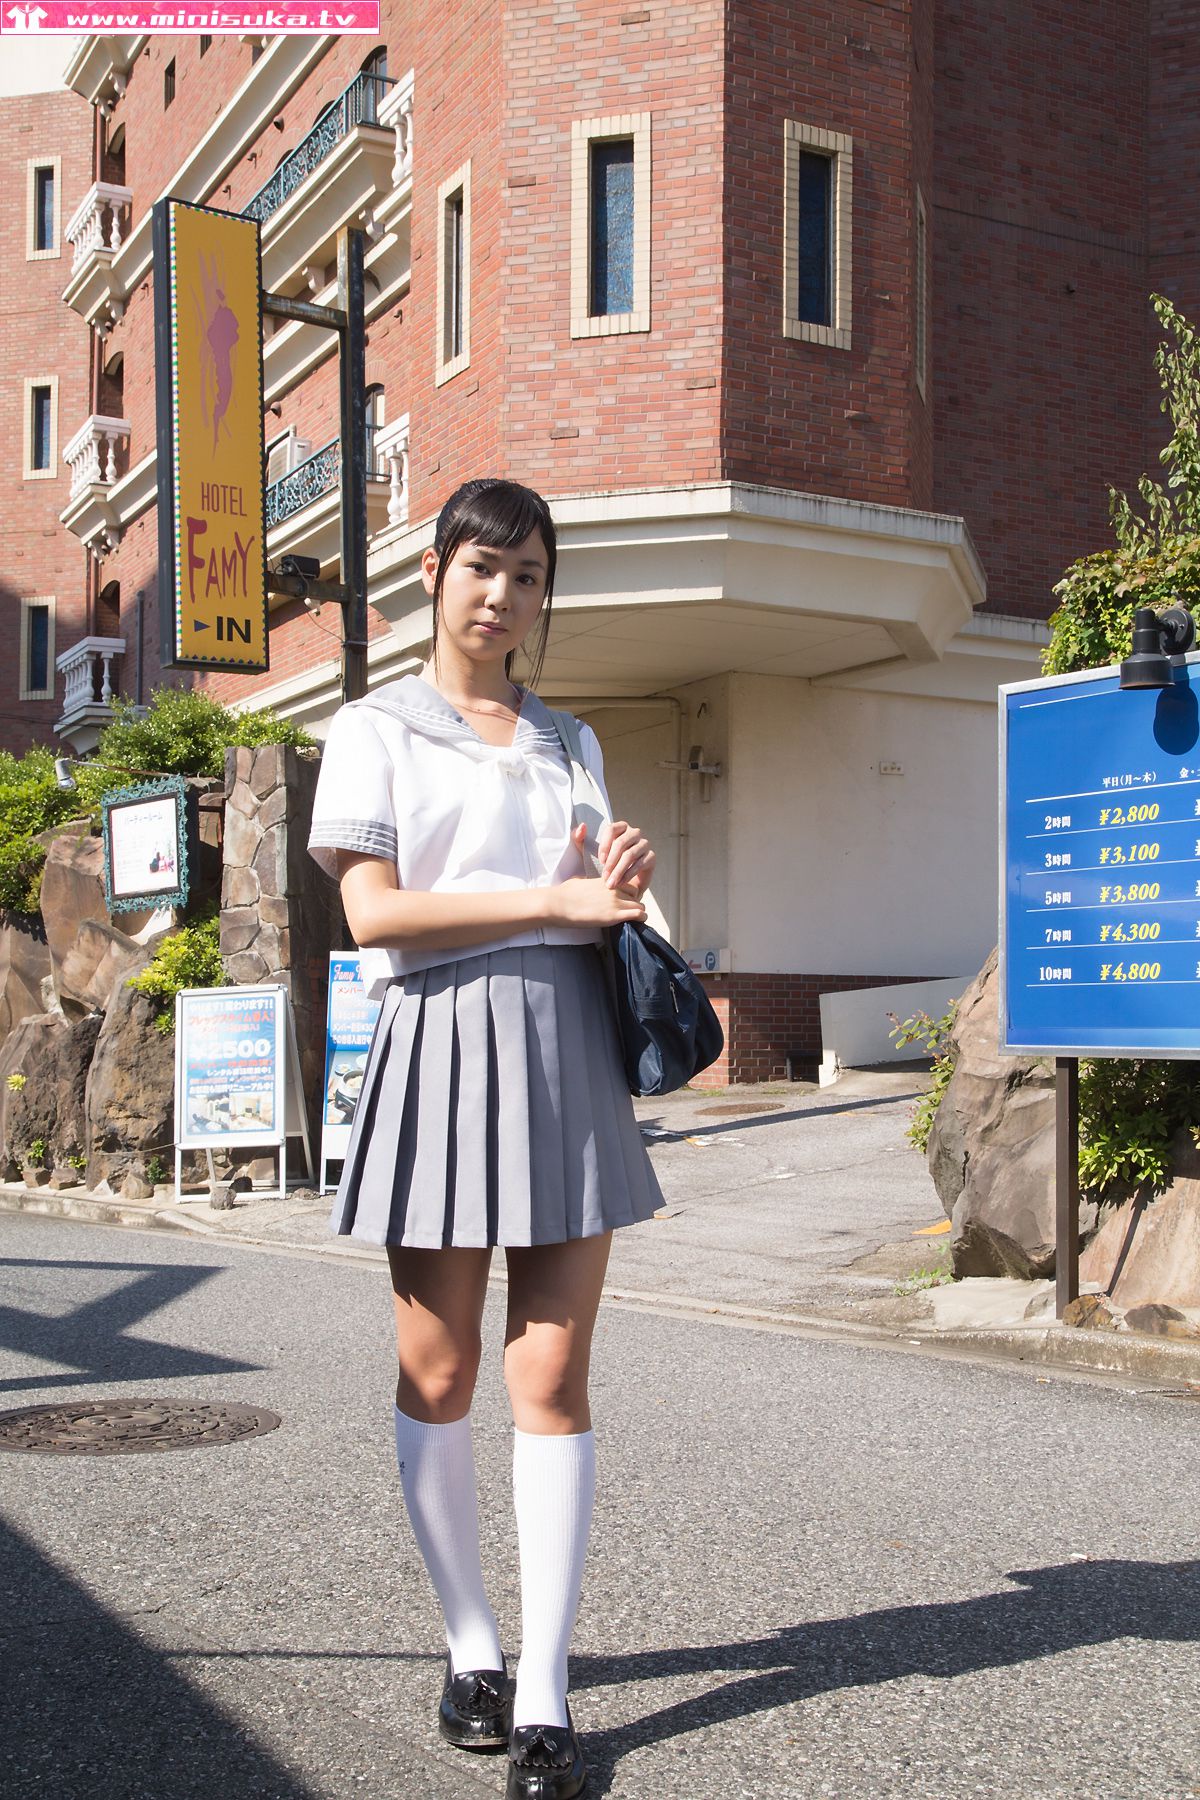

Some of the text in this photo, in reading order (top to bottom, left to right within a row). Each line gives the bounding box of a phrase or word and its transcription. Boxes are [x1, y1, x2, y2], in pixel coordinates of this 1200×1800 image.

[201, 481, 247, 517] HOTEL
[216, 616, 251, 644] IN
[1044, 803, 1160, 830] 2時間 ¥2,800
[1045, 843, 1160, 867] 3時間 ¥3,100
[1045, 883, 1160, 905] 5時間 ¥3,800
[1045, 922, 1161, 943] 7時間 ¥4,300
[1039, 962, 1161, 981] 10時間 ¥4,800
